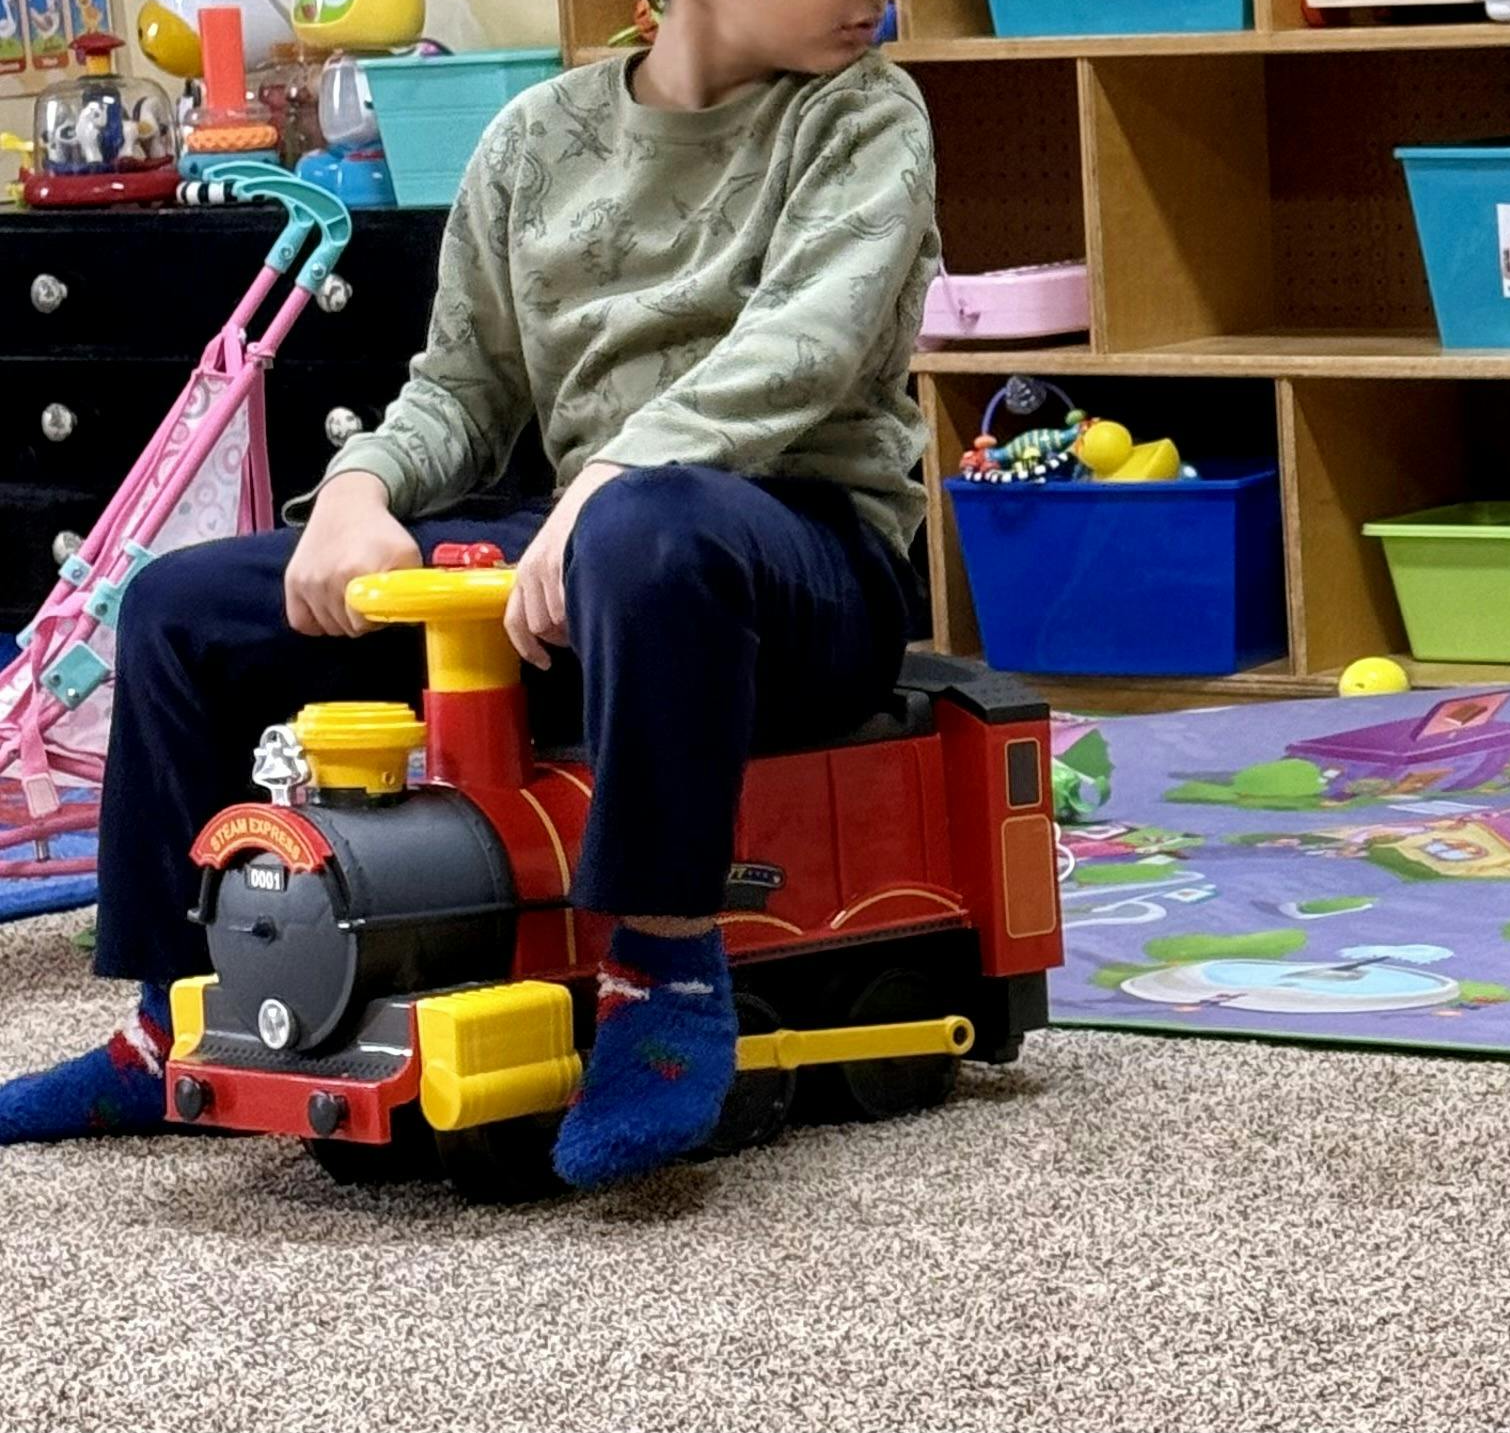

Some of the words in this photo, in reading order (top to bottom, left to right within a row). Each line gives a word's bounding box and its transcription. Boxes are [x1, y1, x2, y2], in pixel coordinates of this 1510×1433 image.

[209, 818, 248, 851] STEAM
[248, 817, 301, 861] EXPRESS
[250, 868, 281, 890] 0001
